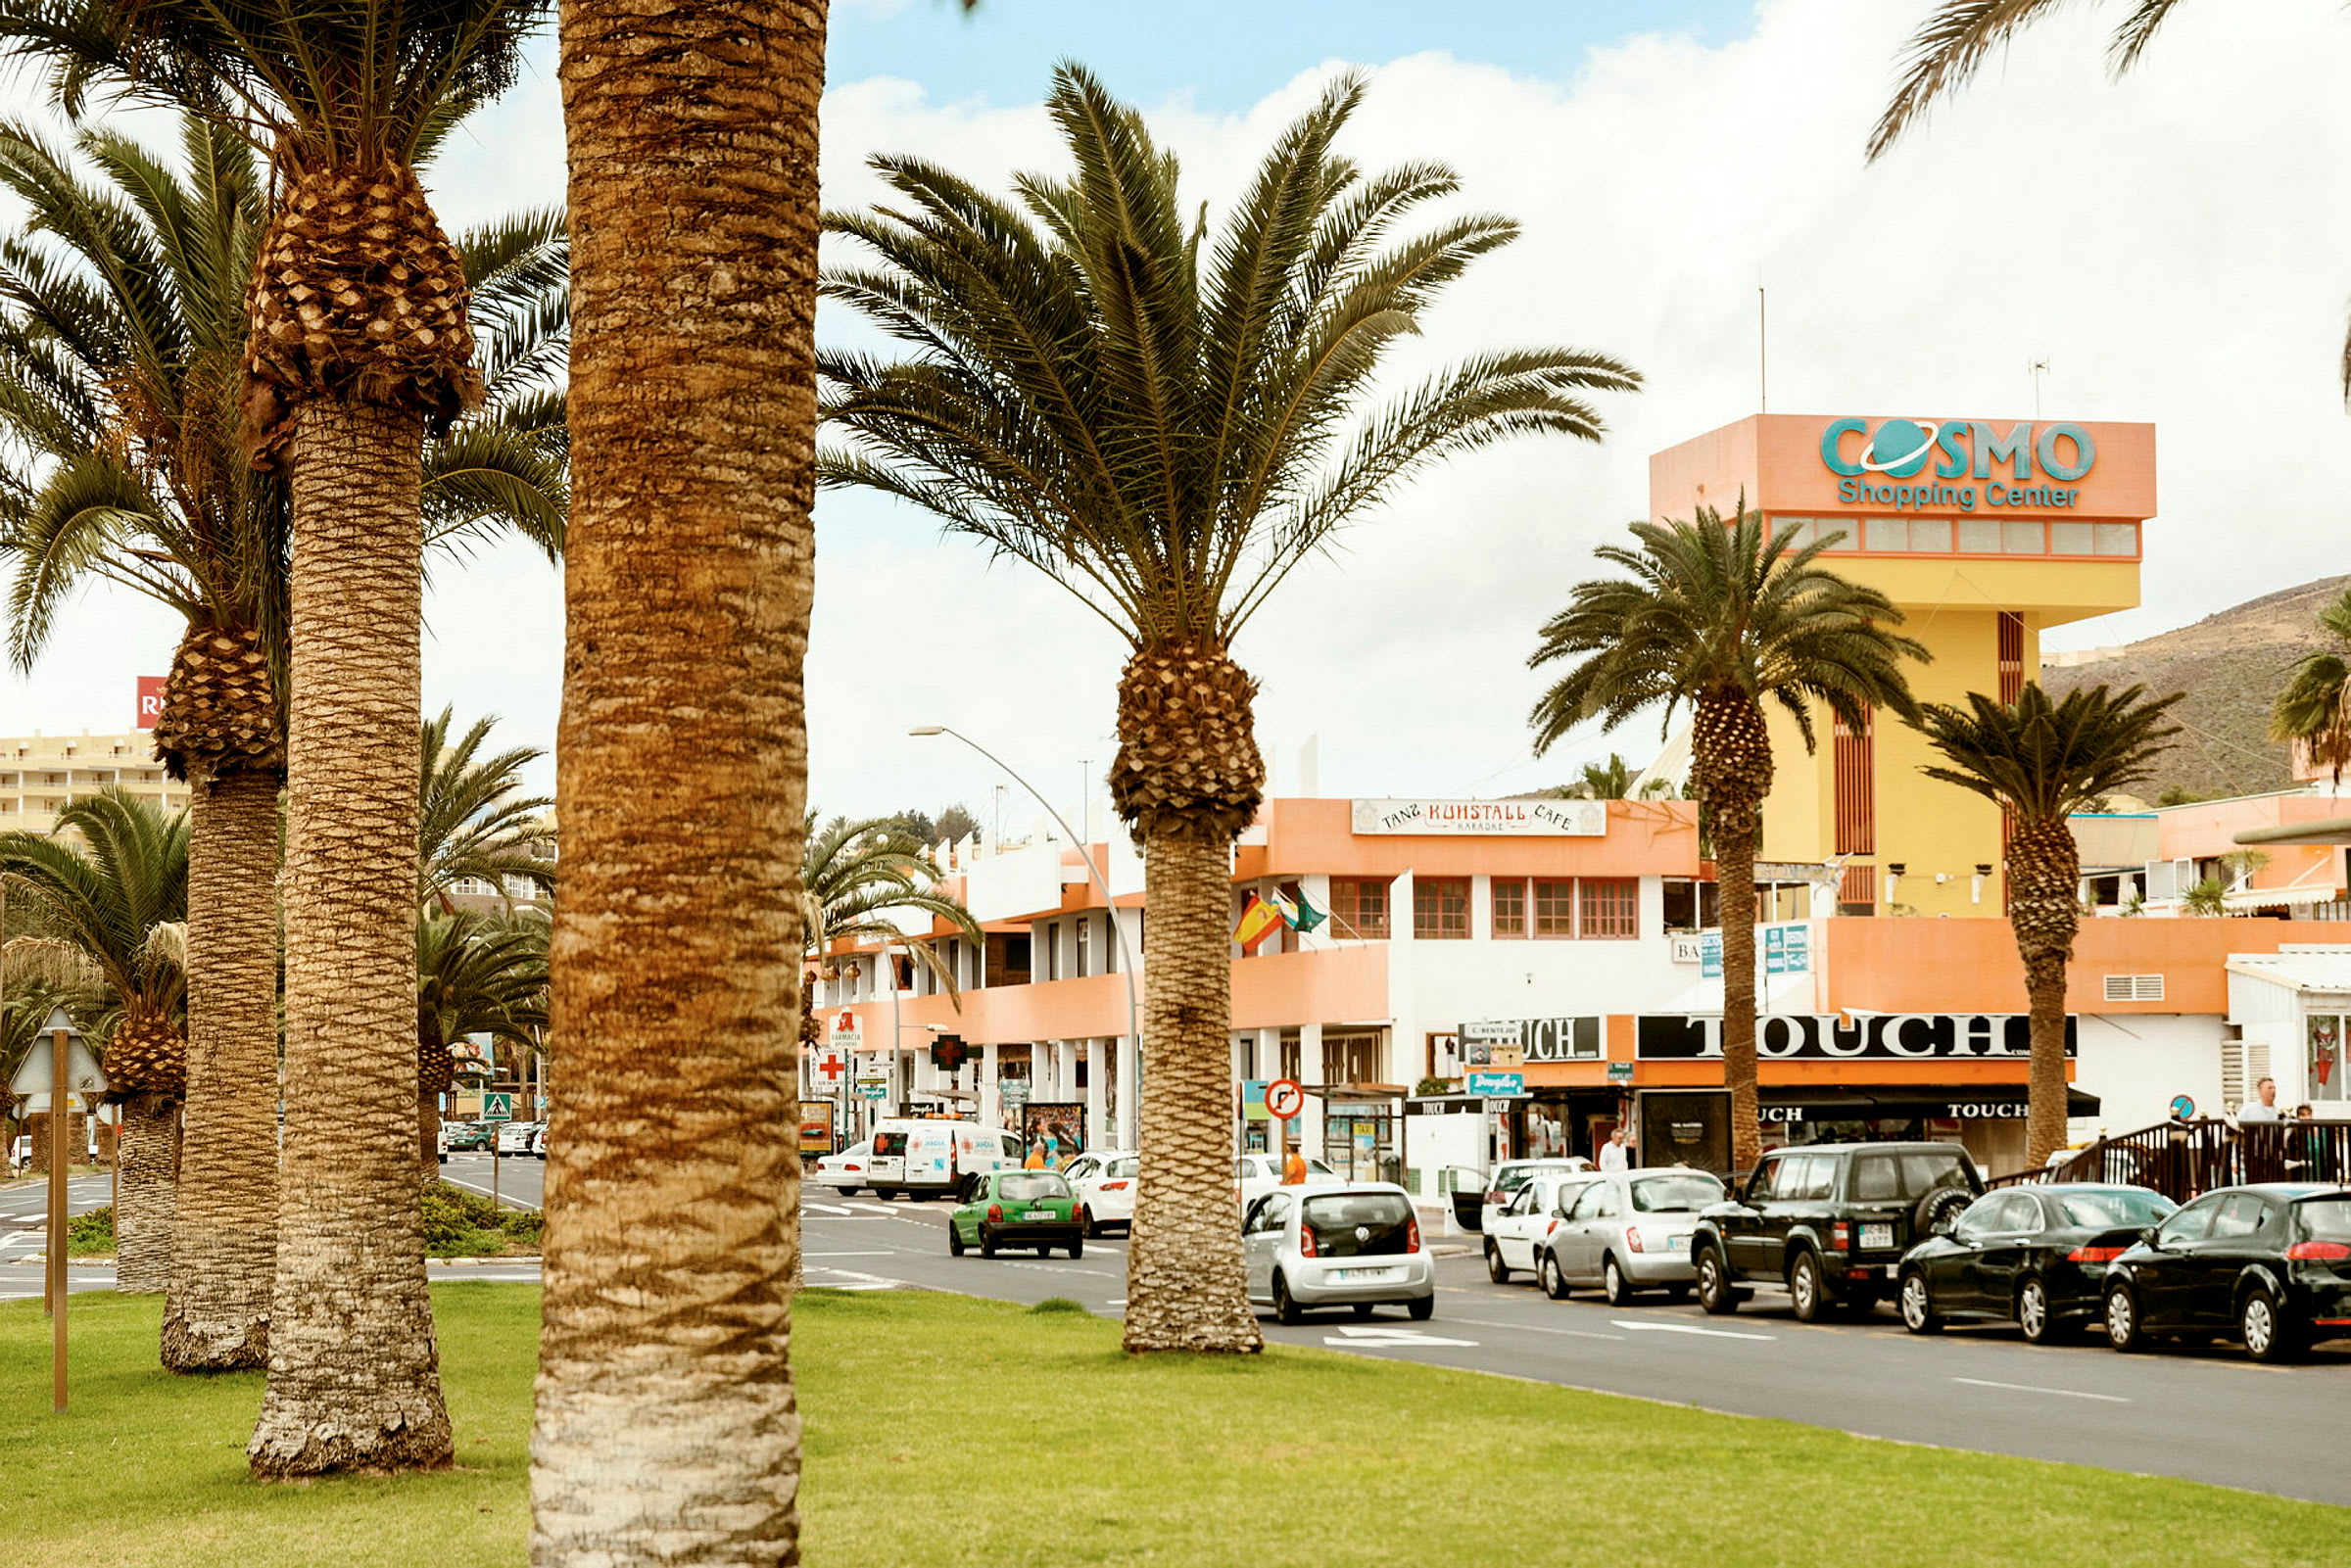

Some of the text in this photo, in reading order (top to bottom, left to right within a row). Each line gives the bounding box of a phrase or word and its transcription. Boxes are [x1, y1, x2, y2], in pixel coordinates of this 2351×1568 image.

[1821, 417, 2095, 481] COSMO
[1839, 478, 2080, 511] Shopping Center
[142, 695, 167, 715] RI
[1381, 803, 1573, 832] TANZ KUHSTALL CAFE
[1678, 944, 1700, 958] BA
[1495, 1019, 1576, 1060] UCH
[1686, 1015, 2013, 1058] TOUCH
[1422, 1102, 1446, 1115] TOUCH
[1488, 1099, 1511, 1114] OUCH
[1756, 1107, 1803, 1122] UCH
[1947, 1103, 2030, 1118] TOUCH
